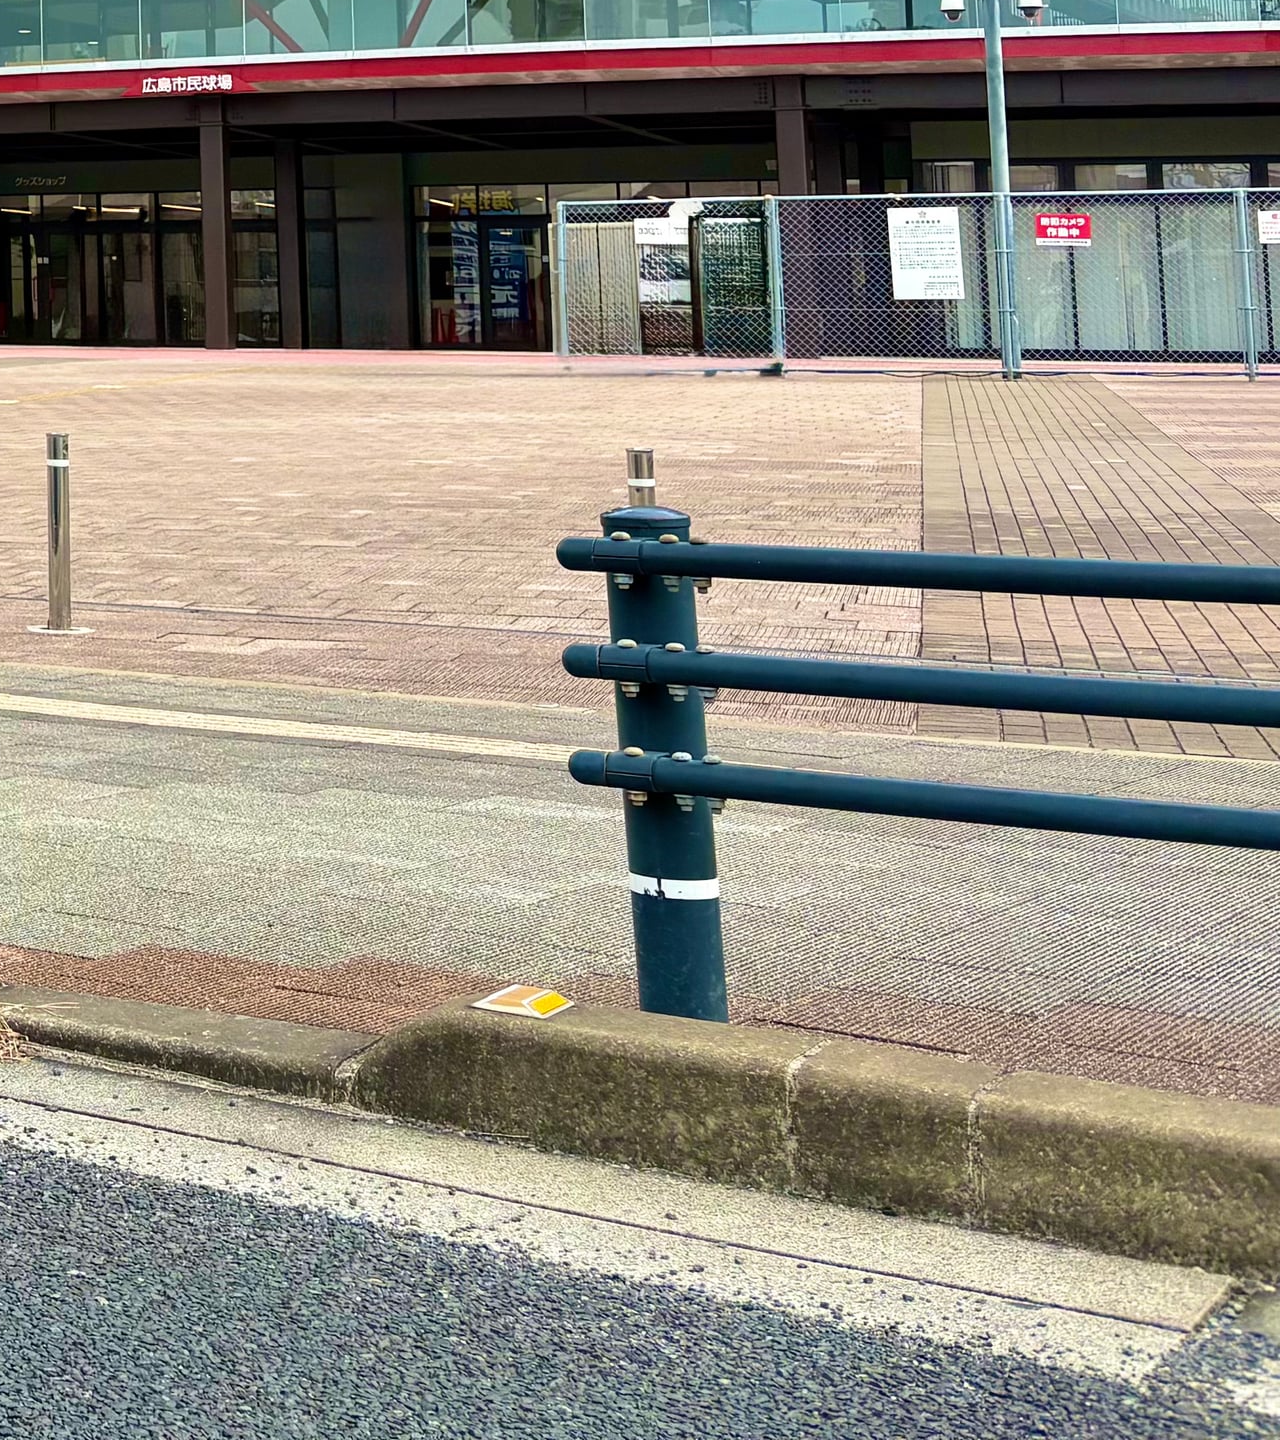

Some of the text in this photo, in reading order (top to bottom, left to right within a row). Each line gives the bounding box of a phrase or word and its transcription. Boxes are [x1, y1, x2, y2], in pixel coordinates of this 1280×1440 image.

[142, 74, 233, 94] 広島市民球場
